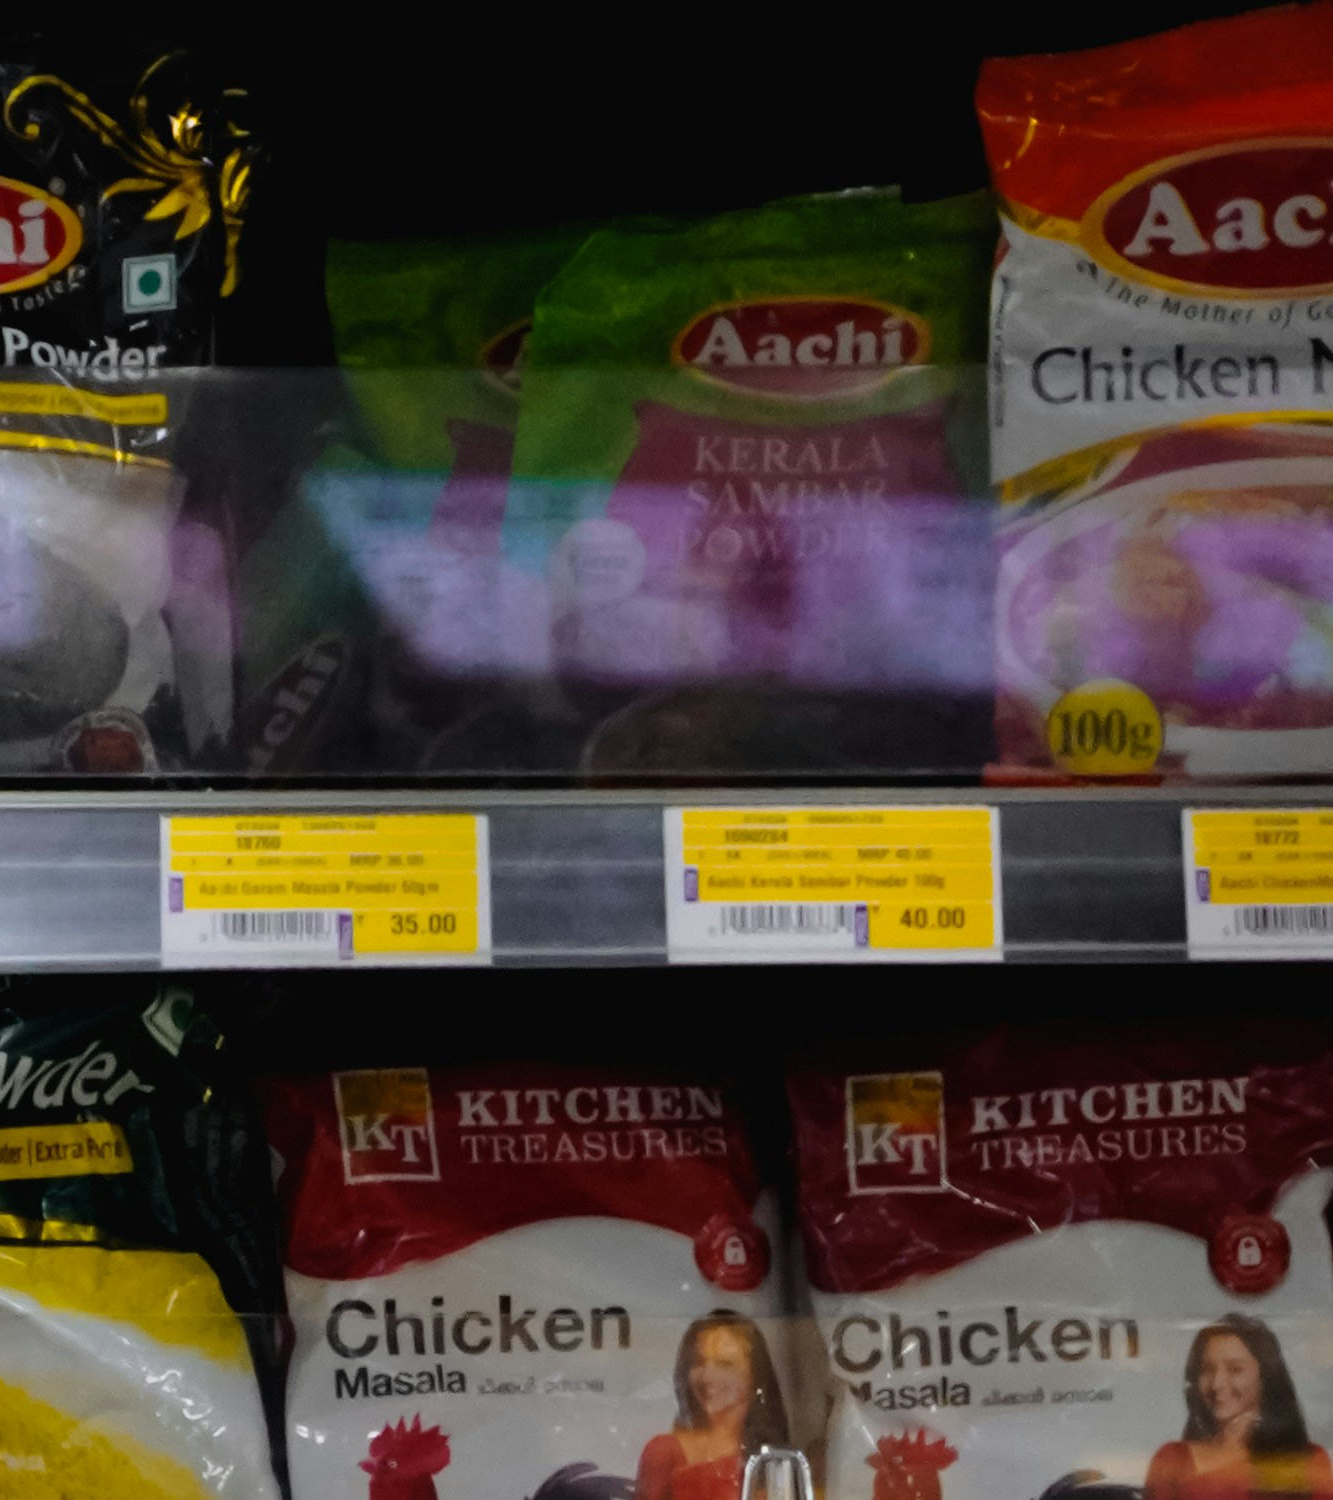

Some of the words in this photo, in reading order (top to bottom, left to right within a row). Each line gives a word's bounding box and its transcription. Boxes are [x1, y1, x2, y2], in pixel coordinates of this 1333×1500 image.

[2, 325, 168, 381] Powder
[693, 316, 906, 371] Aachi
[1030, 344, 1281, 404] Chicken
[1053, 709, 1157, 765] 100g
[391, 911, 457, 937] 35.00
[900, 906, 966, 932] 40.00
[456, 1086, 725, 1128] KITCHEN
[461, 1129, 729, 1165] TREASURES
[325, 1295, 632, 1359] Chicken
[832, 1309, 1141, 1375] Chicken
[334, 1365, 468, 1399] Masala
